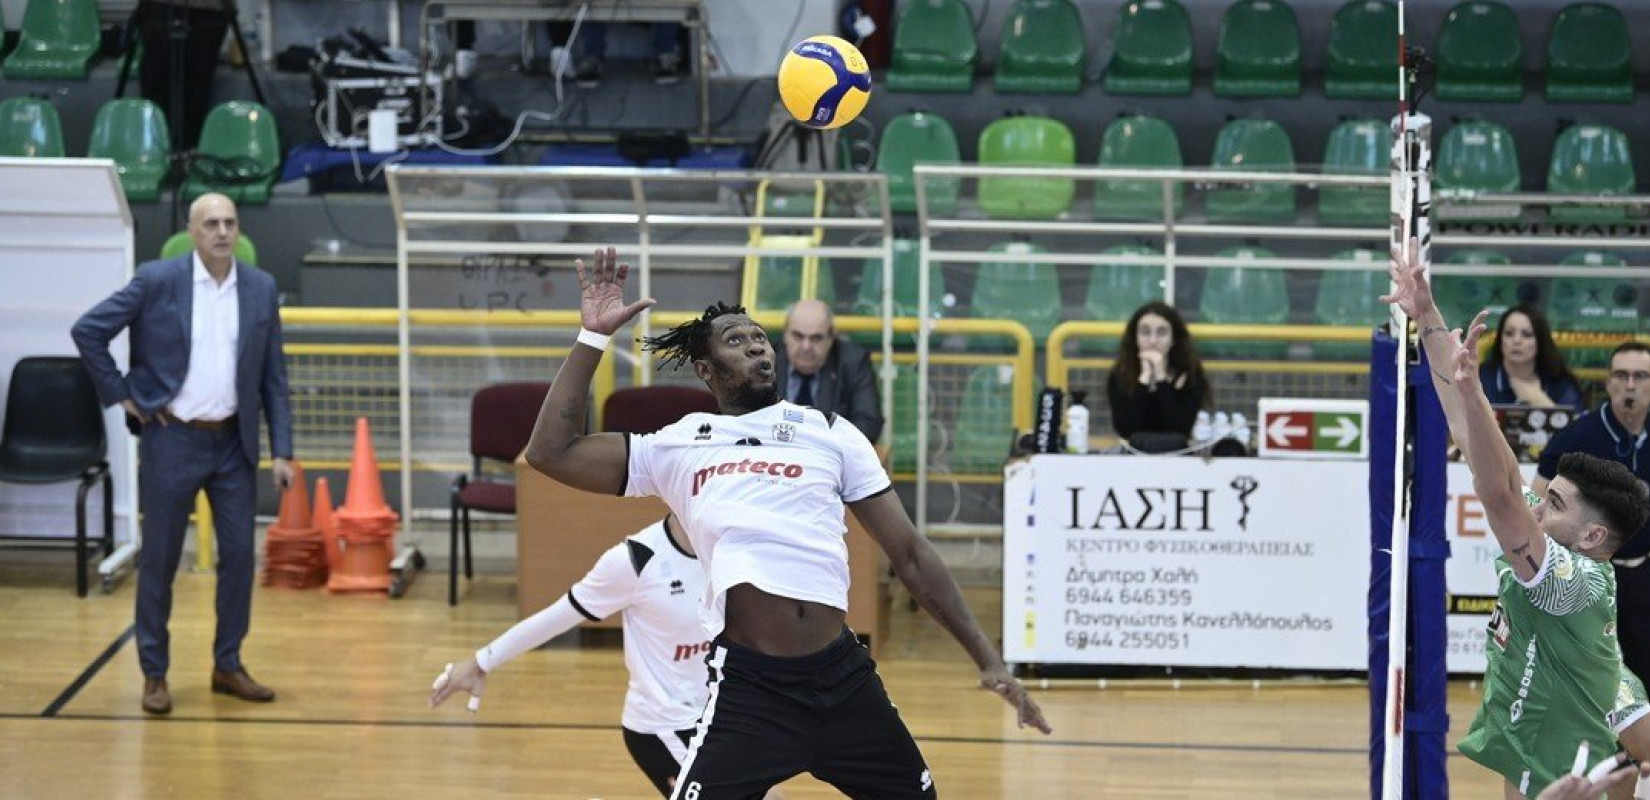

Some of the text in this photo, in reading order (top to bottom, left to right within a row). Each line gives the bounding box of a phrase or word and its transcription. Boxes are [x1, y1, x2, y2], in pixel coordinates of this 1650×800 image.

[692, 458, 803, 497] mateco
[1066, 487, 1214, 531] ΙΑΣΗ
[1066, 539, 1315, 557] ΚΕΝΤΡΟ ΦΥΣΙΚΟΘΕΡΑΠΕΙΑΣ
[1150, 567, 1199, 585] Χαλή
[1065, 588, 1192, 606] 6944 646359
[1065, 609, 1333, 631] Παναγιώτης Κανελλόπουλος
[1119, 632, 1190, 649] 255051
[685, 781, 702, 800] 6
